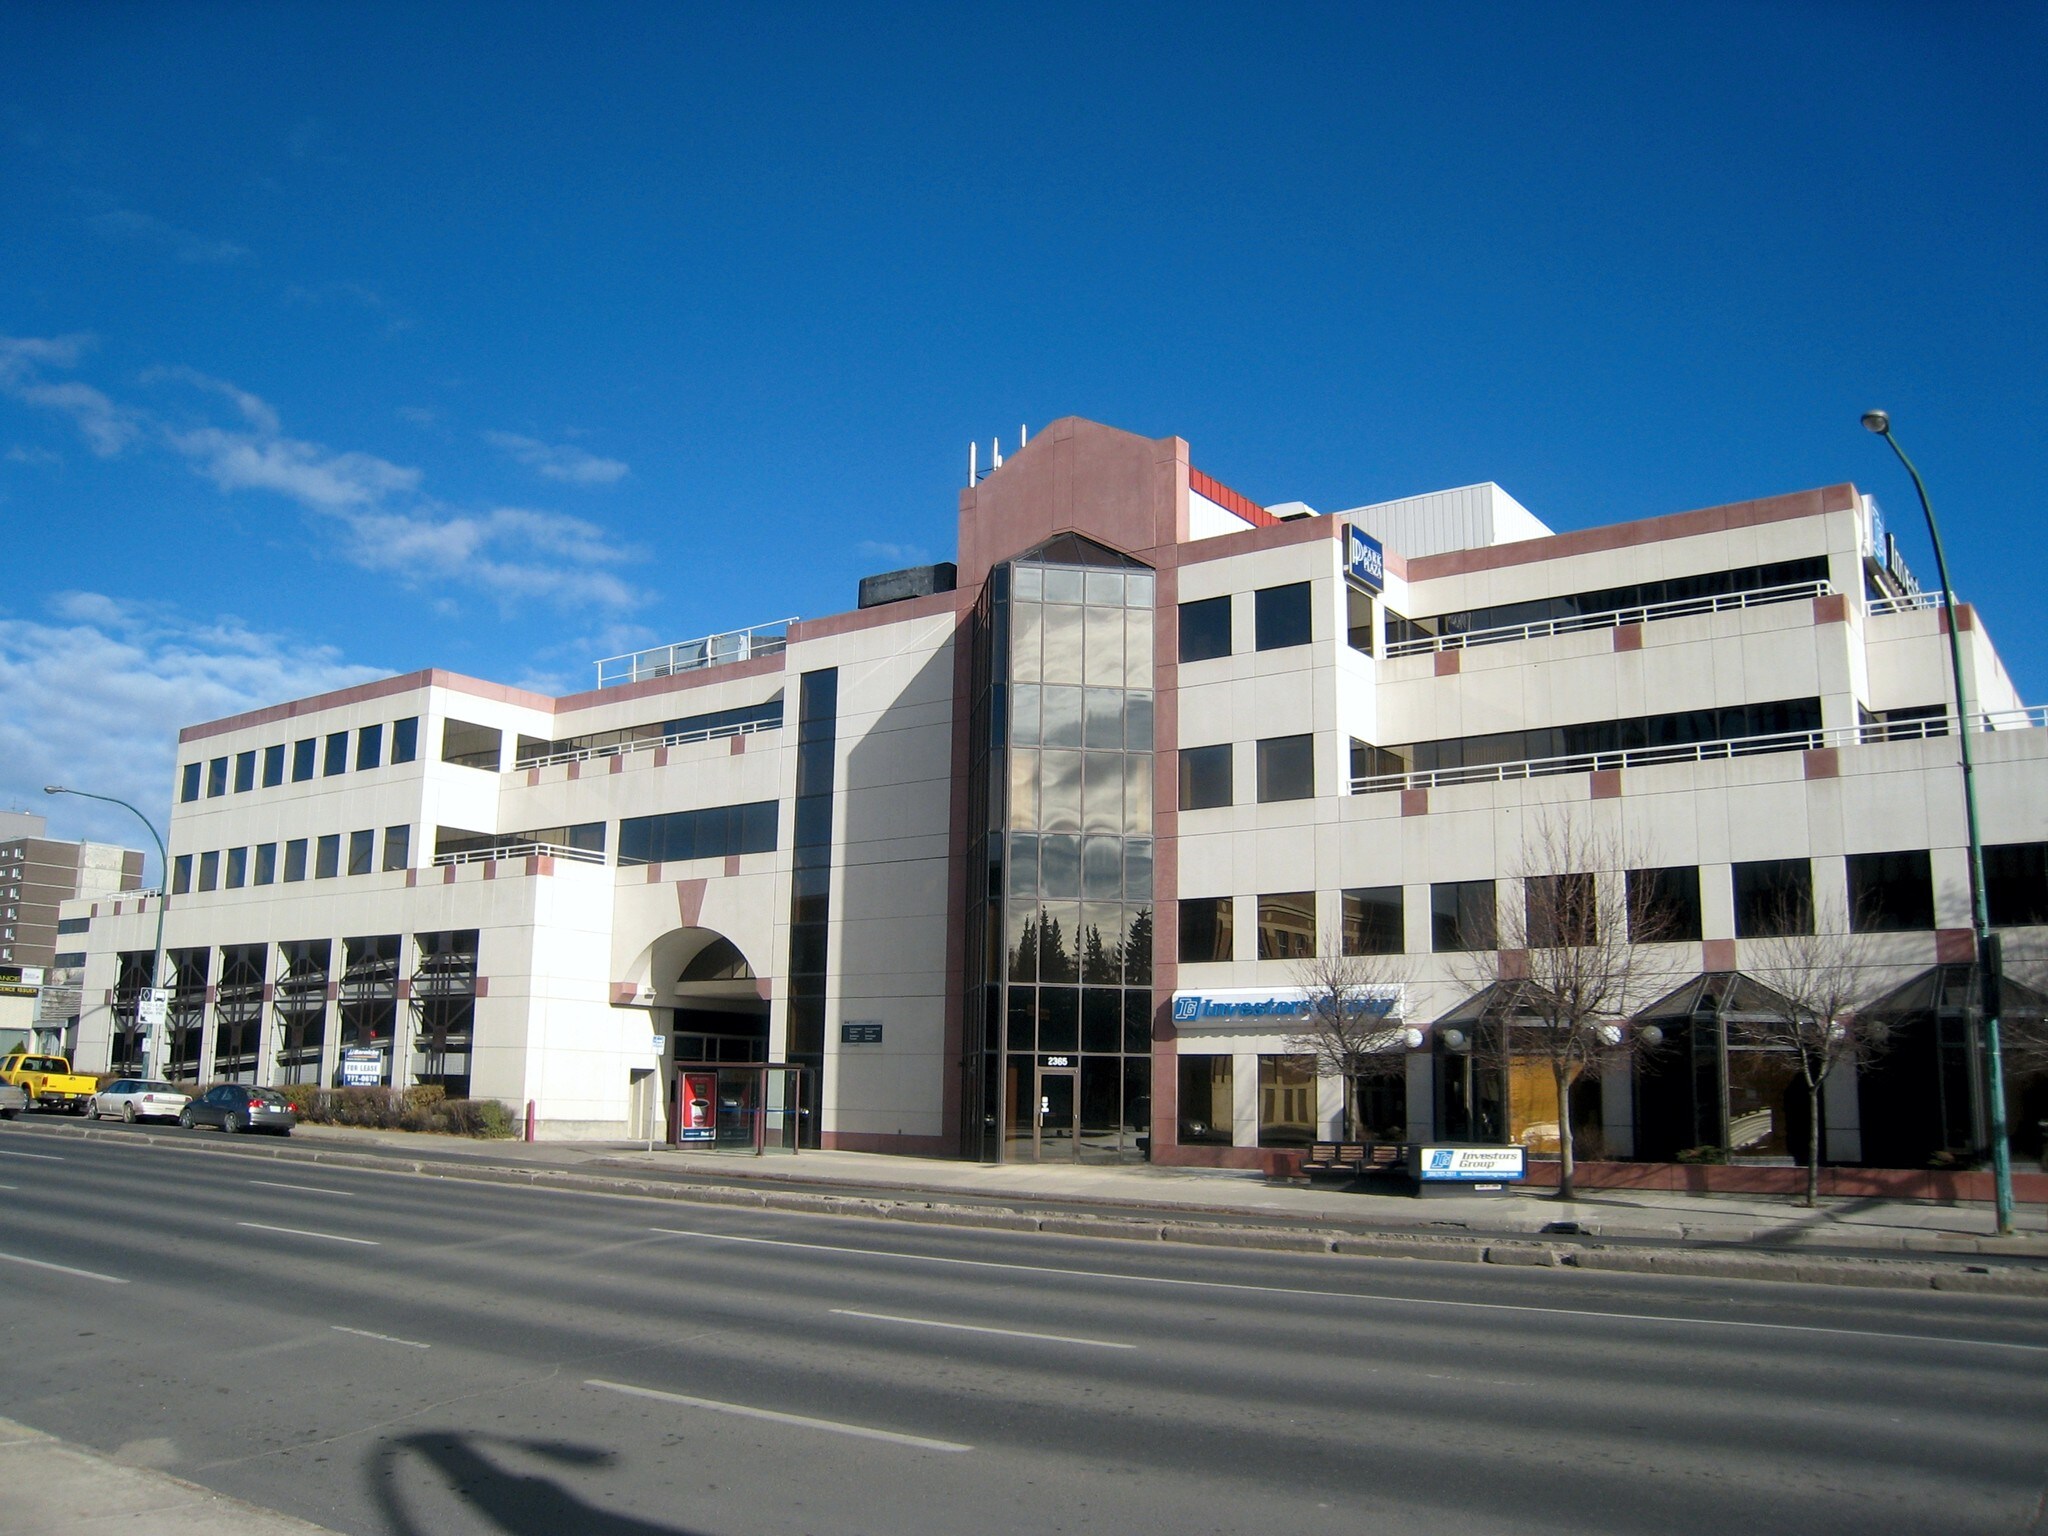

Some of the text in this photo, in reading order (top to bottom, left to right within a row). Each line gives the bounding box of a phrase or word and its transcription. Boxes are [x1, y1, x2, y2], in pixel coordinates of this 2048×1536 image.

[1363, 544, 1382, 567] PARK
[1363, 558, 1382, 579] PLAZA
[1202, 997, 1315, 1018] Investors
[1319, 995, 1395, 1018] Goup
[1047, 1056, 1068, 1067] 2365
[347, 1064, 378, 1072] FOR LEASE
[1461, 1152, 1518, 1161] Investors
[1458, 1160, 1495, 1169] Group
